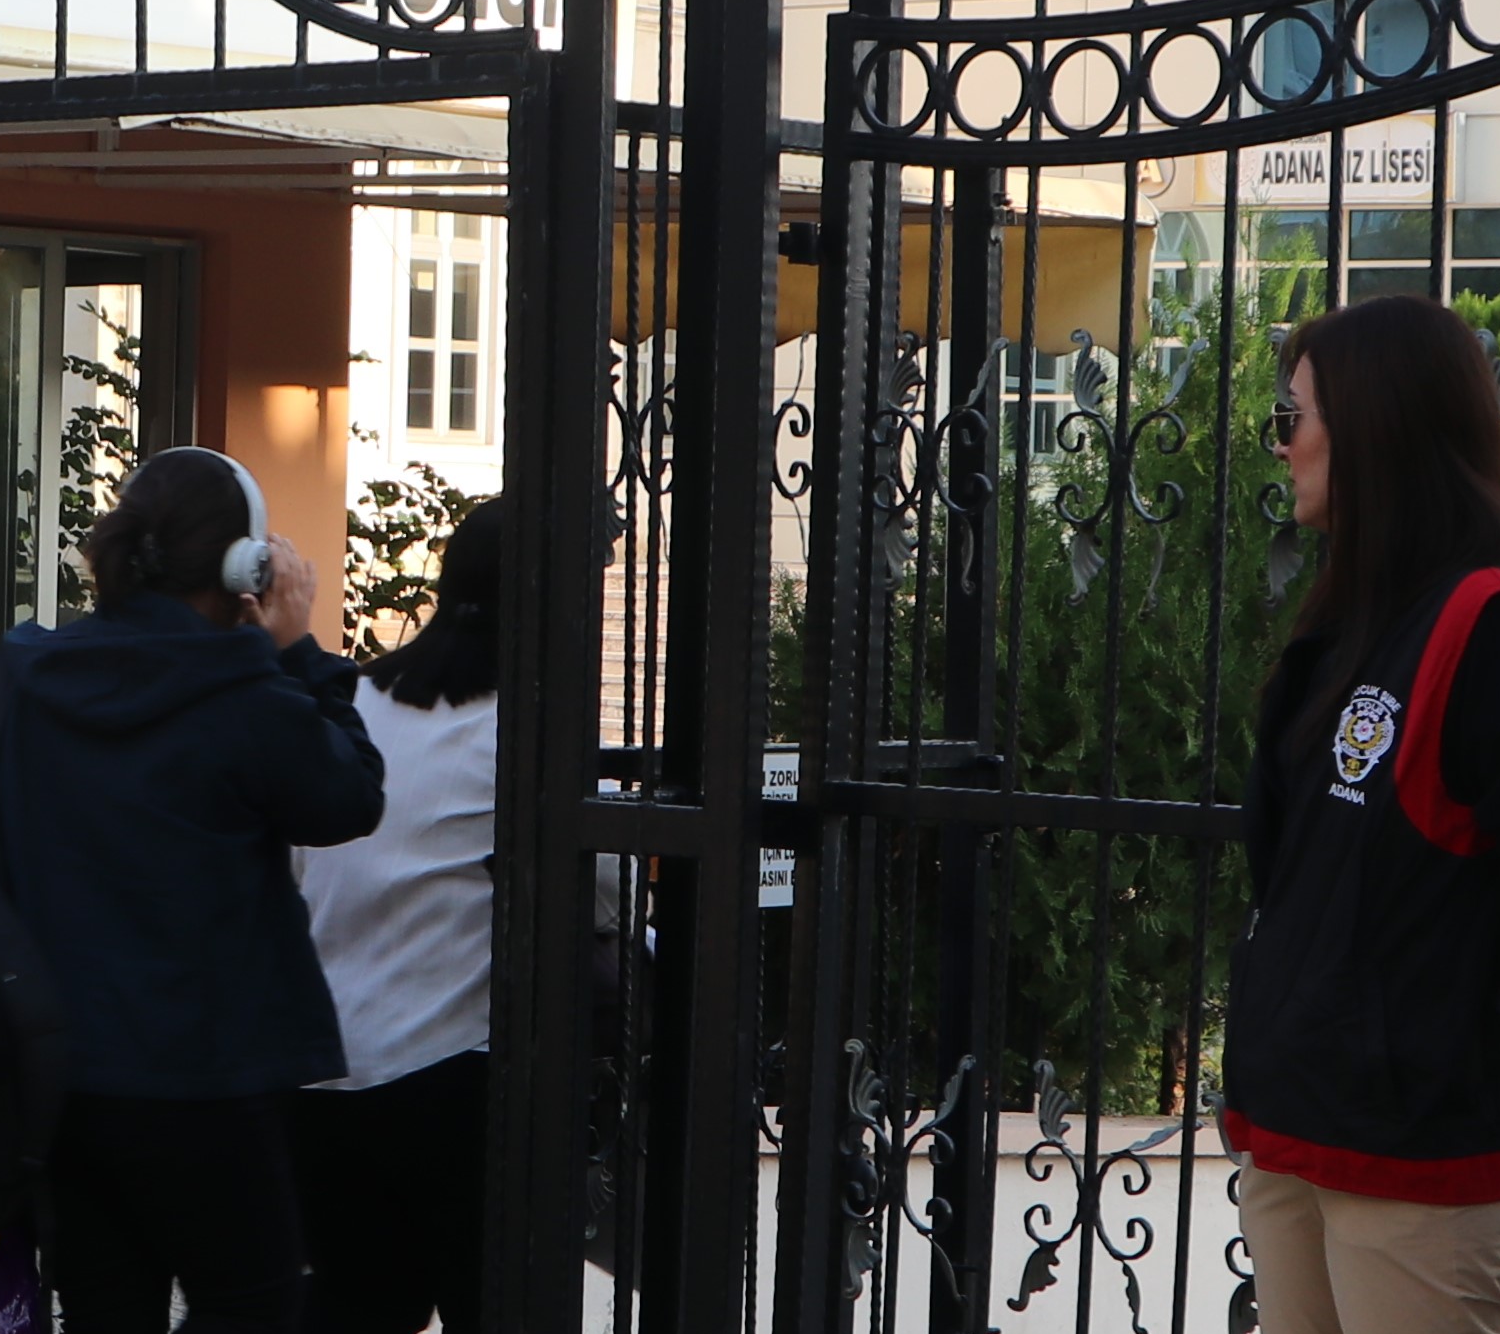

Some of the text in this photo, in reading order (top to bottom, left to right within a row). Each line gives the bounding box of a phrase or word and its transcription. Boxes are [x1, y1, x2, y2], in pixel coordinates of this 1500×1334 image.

[1261, 140, 1430, 184] ADANA IZ LİSESİ
[1328, 783, 1366, 805] ADANA
